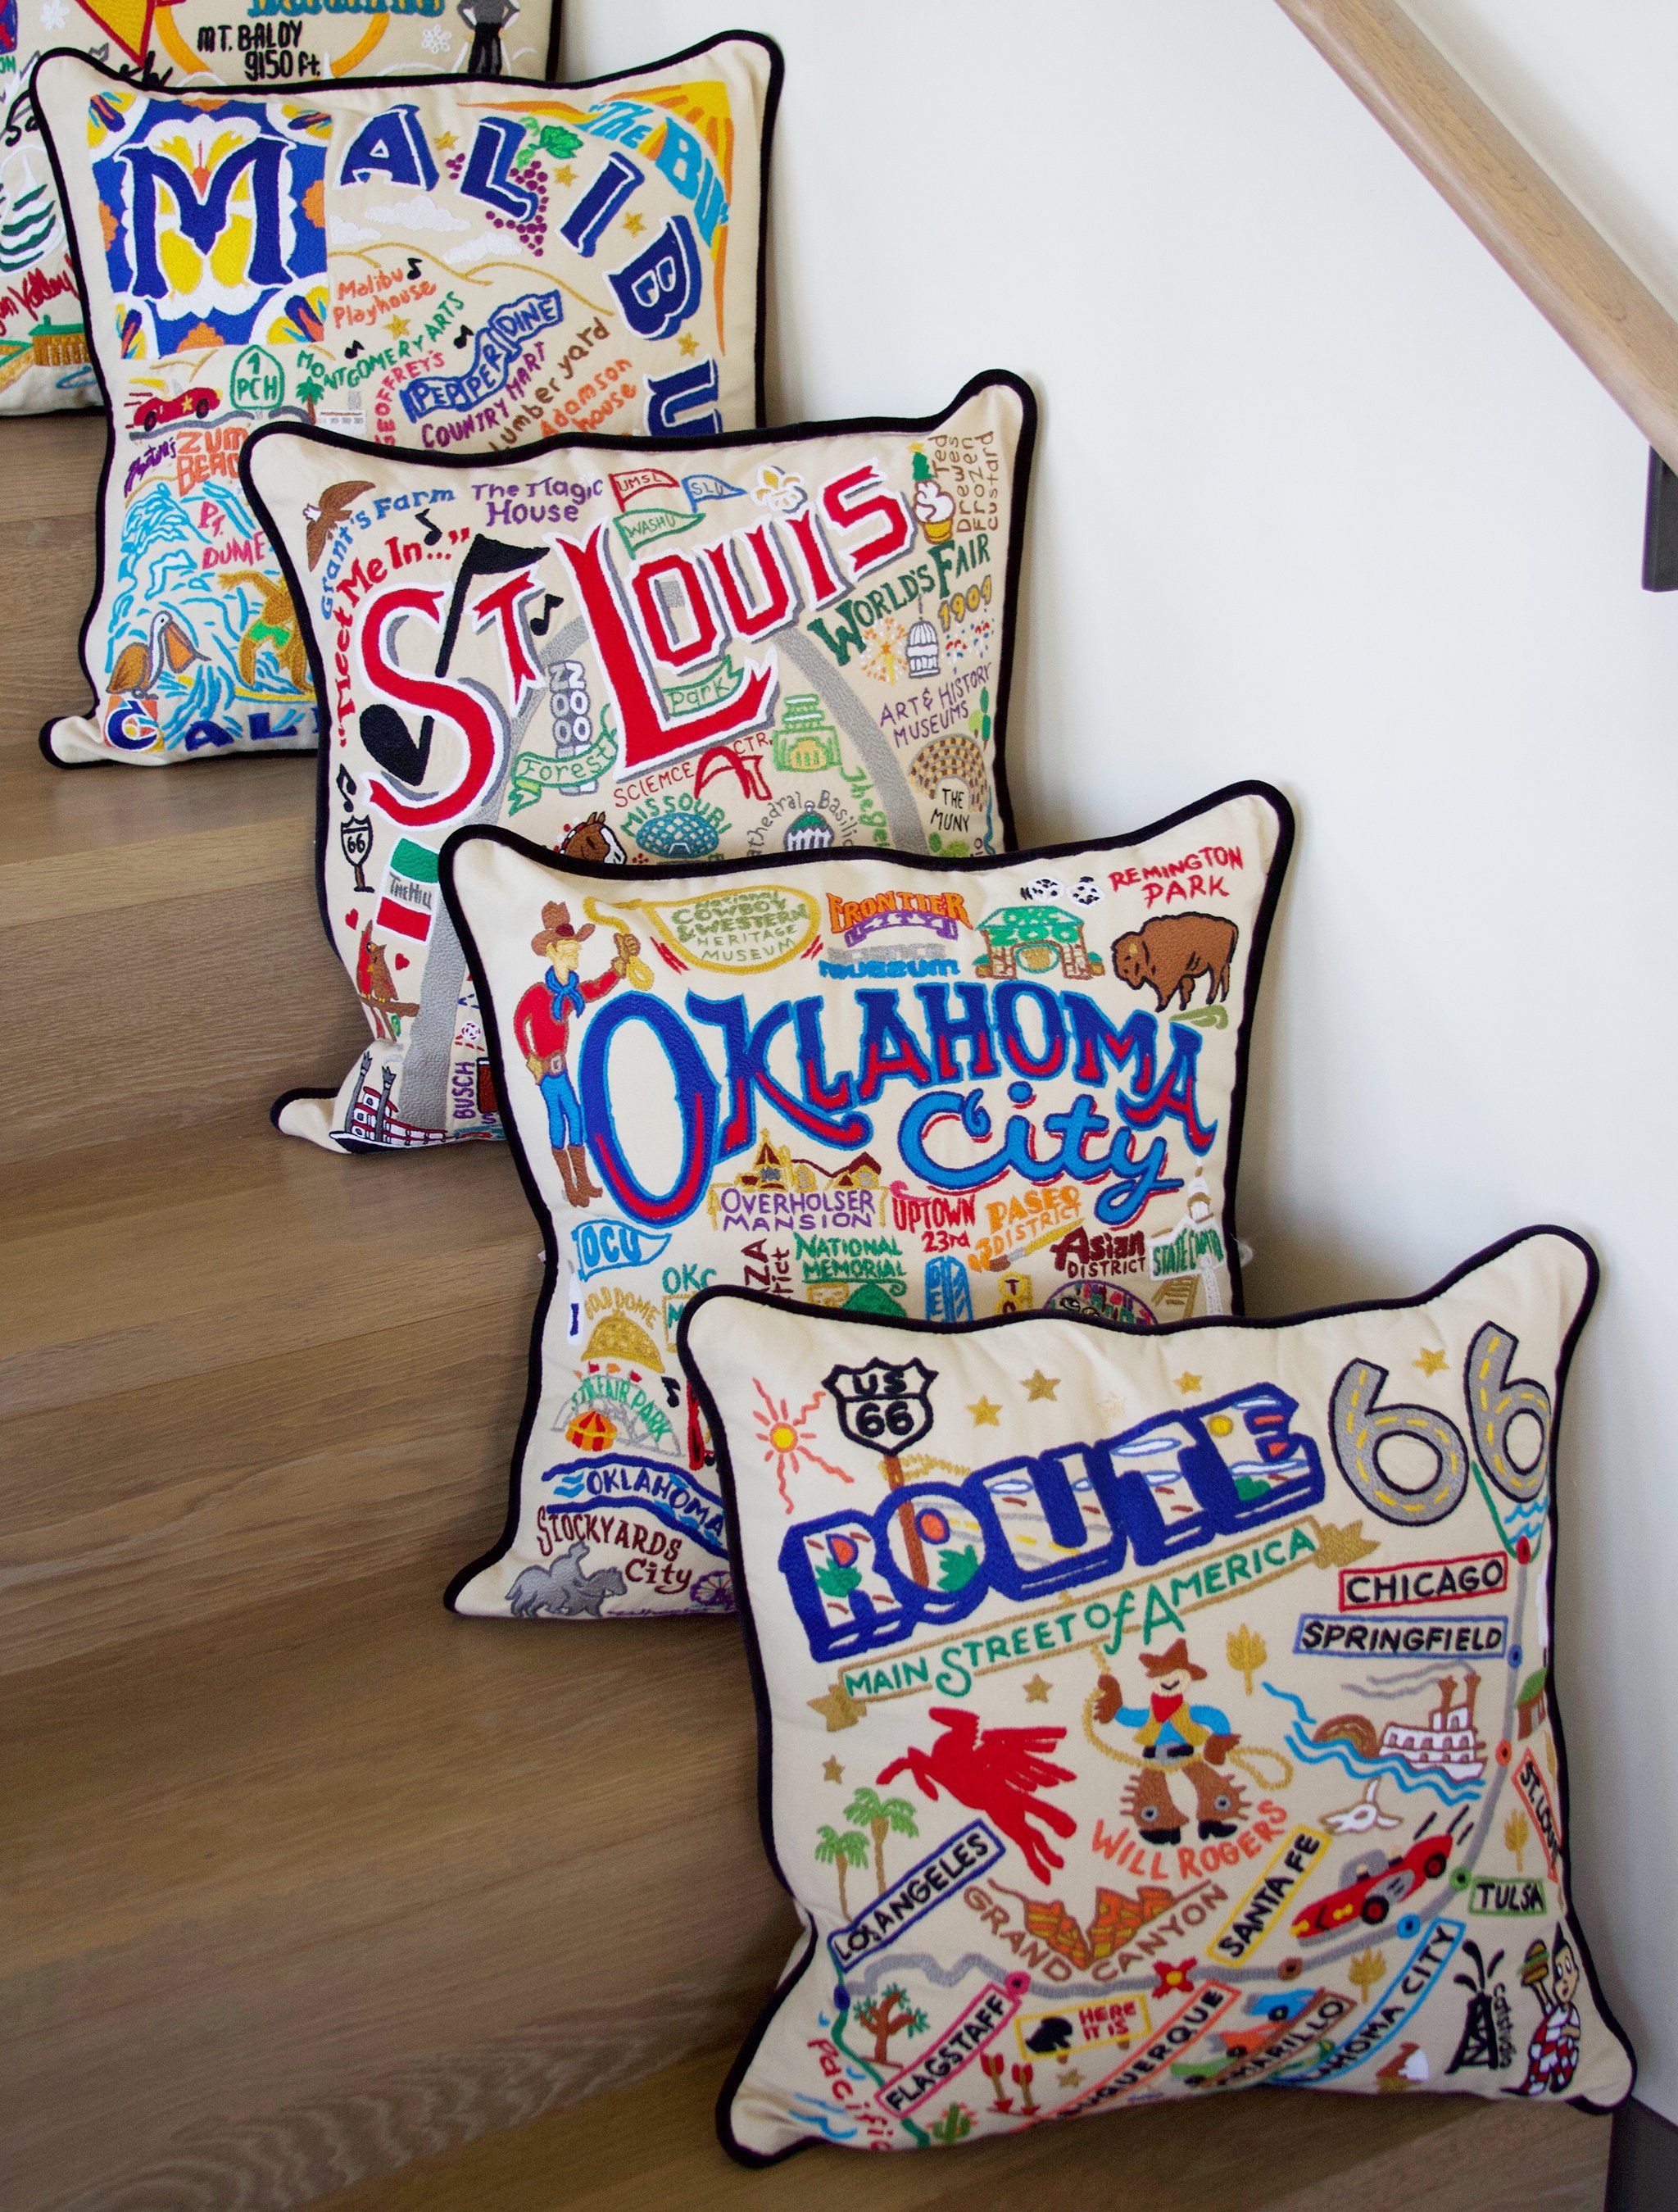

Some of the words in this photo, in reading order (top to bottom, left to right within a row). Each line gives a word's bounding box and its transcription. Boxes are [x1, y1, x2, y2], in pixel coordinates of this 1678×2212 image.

[197, 25, 233, 52] MT.
[238, 21, 302, 50] BALDY
[244, 51, 295, 80] 9150
[333, 279, 437, 329] Playhouse
[338, 266, 404, 300] Malibu
[297, 338, 424, 391] MONTGOMERY
[424, 291, 465, 343] ARTS
[560, 316, 611, 379] yard
[236, 377, 279, 401] PCH
[421, 398, 507, 448] COUNTRY
[506, 341, 546, 402] MART
[540, 358, 633, 438] Adamson
[176, 427, 248, 454] ZUM
[927, 434, 950, 479] Ted
[176, 452, 241, 497] BEAC
[471, 483, 519, 501] The
[525, 476, 604, 506] Magic
[616, 473, 662, 493] UMSL
[691, 479, 724, 497] SLU
[949, 436, 972, 533] Drewes
[486, 498, 579, 527] House
[624, 514, 677, 538] WASHU
[202, 531, 266, 570] DUME
[320, 509, 371, 620] Grant's
[374, 488, 456, 520] Farm
[336, 557, 388, 608] Me
[807, 564, 936, 667] WORLD'S
[927, 534, 991, 599] FAIR
[937, 574, 992, 632] 1904
[541, 457, 917, 784] LOUIS
[880, 696, 919, 727] ART
[923, 687, 934, 711] &
[938, 661, 993, 705] HISTORY
[893, 700, 969, 749] MUSEUMS
[520, 744, 616, 783] Forest
[620, 792, 733, 840] MISSOURI
[930, 808, 970, 833] MUNY
[942, 788, 964, 810] THE
[347, 833, 366, 852] 66
[1108, 845, 1245, 893] REMINGTON
[671, 898, 787, 925] COWBOY
[825, 890, 974, 934] FRONTIER
[1142, 874, 1231, 910] PARK
[697, 924, 798, 947] HERITAGE
[701, 937, 796, 962] MUSEUM
[451, 1061, 476, 1120] BUSCH
[577, 979, 1218, 1231] OKLAHOMA
[898, 1081, 1185, 1231] City
[720, 1188, 876, 1216] OVERHOLSER
[723, 1211, 873, 1232] MANSION
[891, 1193, 976, 1234] UPTOWN
[986, 1185, 1082, 1232] PASEO
[581, 1225, 643, 1268] OCU
[793, 1231, 904, 1260] NATIONAL
[921, 1230, 971, 1253] 23rd
[990, 1200, 1083, 1258] DISTRICT
[802, 1259, 907, 1279] MEMORIAL
[1067, 1256, 1146, 1279] DISTRICT
[854, 1370, 907, 1394] US
[855, 1402, 914, 1440] 66
[586, 1467, 724, 1537] OKLAHOMA
[778, 1381, 1327, 1663] ROUTE
[1327, 1320, 1551, 1527] 66
[537, 1505, 683, 1562] STOCKYARDS
[624, 1557, 692, 1595] City
[1345, 1559, 1505, 1606] CHICAGO
[845, 1656, 930, 1696] MAIN
[934, 1615, 1075, 1698] STREET
[1141, 1527, 1317, 1645] AMERICA
[1301, 1619, 1503, 1652] SPRINGFIELD
[1091, 1818, 1169, 1881] WILL
[1176, 1798, 1288, 1880] ROGERS
[874, 1832, 989, 1934] ANGELES
[1218, 1875, 1295, 1958] SANTA
[1284, 1833, 1321, 1874] FE
[1476, 1883, 1544, 1910] TULSA
[963, 1884, 1073, 1983] GRAND
[1091, 1883, 1229, 1983] CANYON
[1402, 1925, 1454, 1995] CITY
[1078, 2001, 1136, 2026] HERE
[1082, 2024, 1100, 2042] IT
[1107, 2019, 1129, 2037] IS
[886, 1994, 1005, 2111] FLAGSTAFF
[807, 2038, 894, 2151] Pacific
